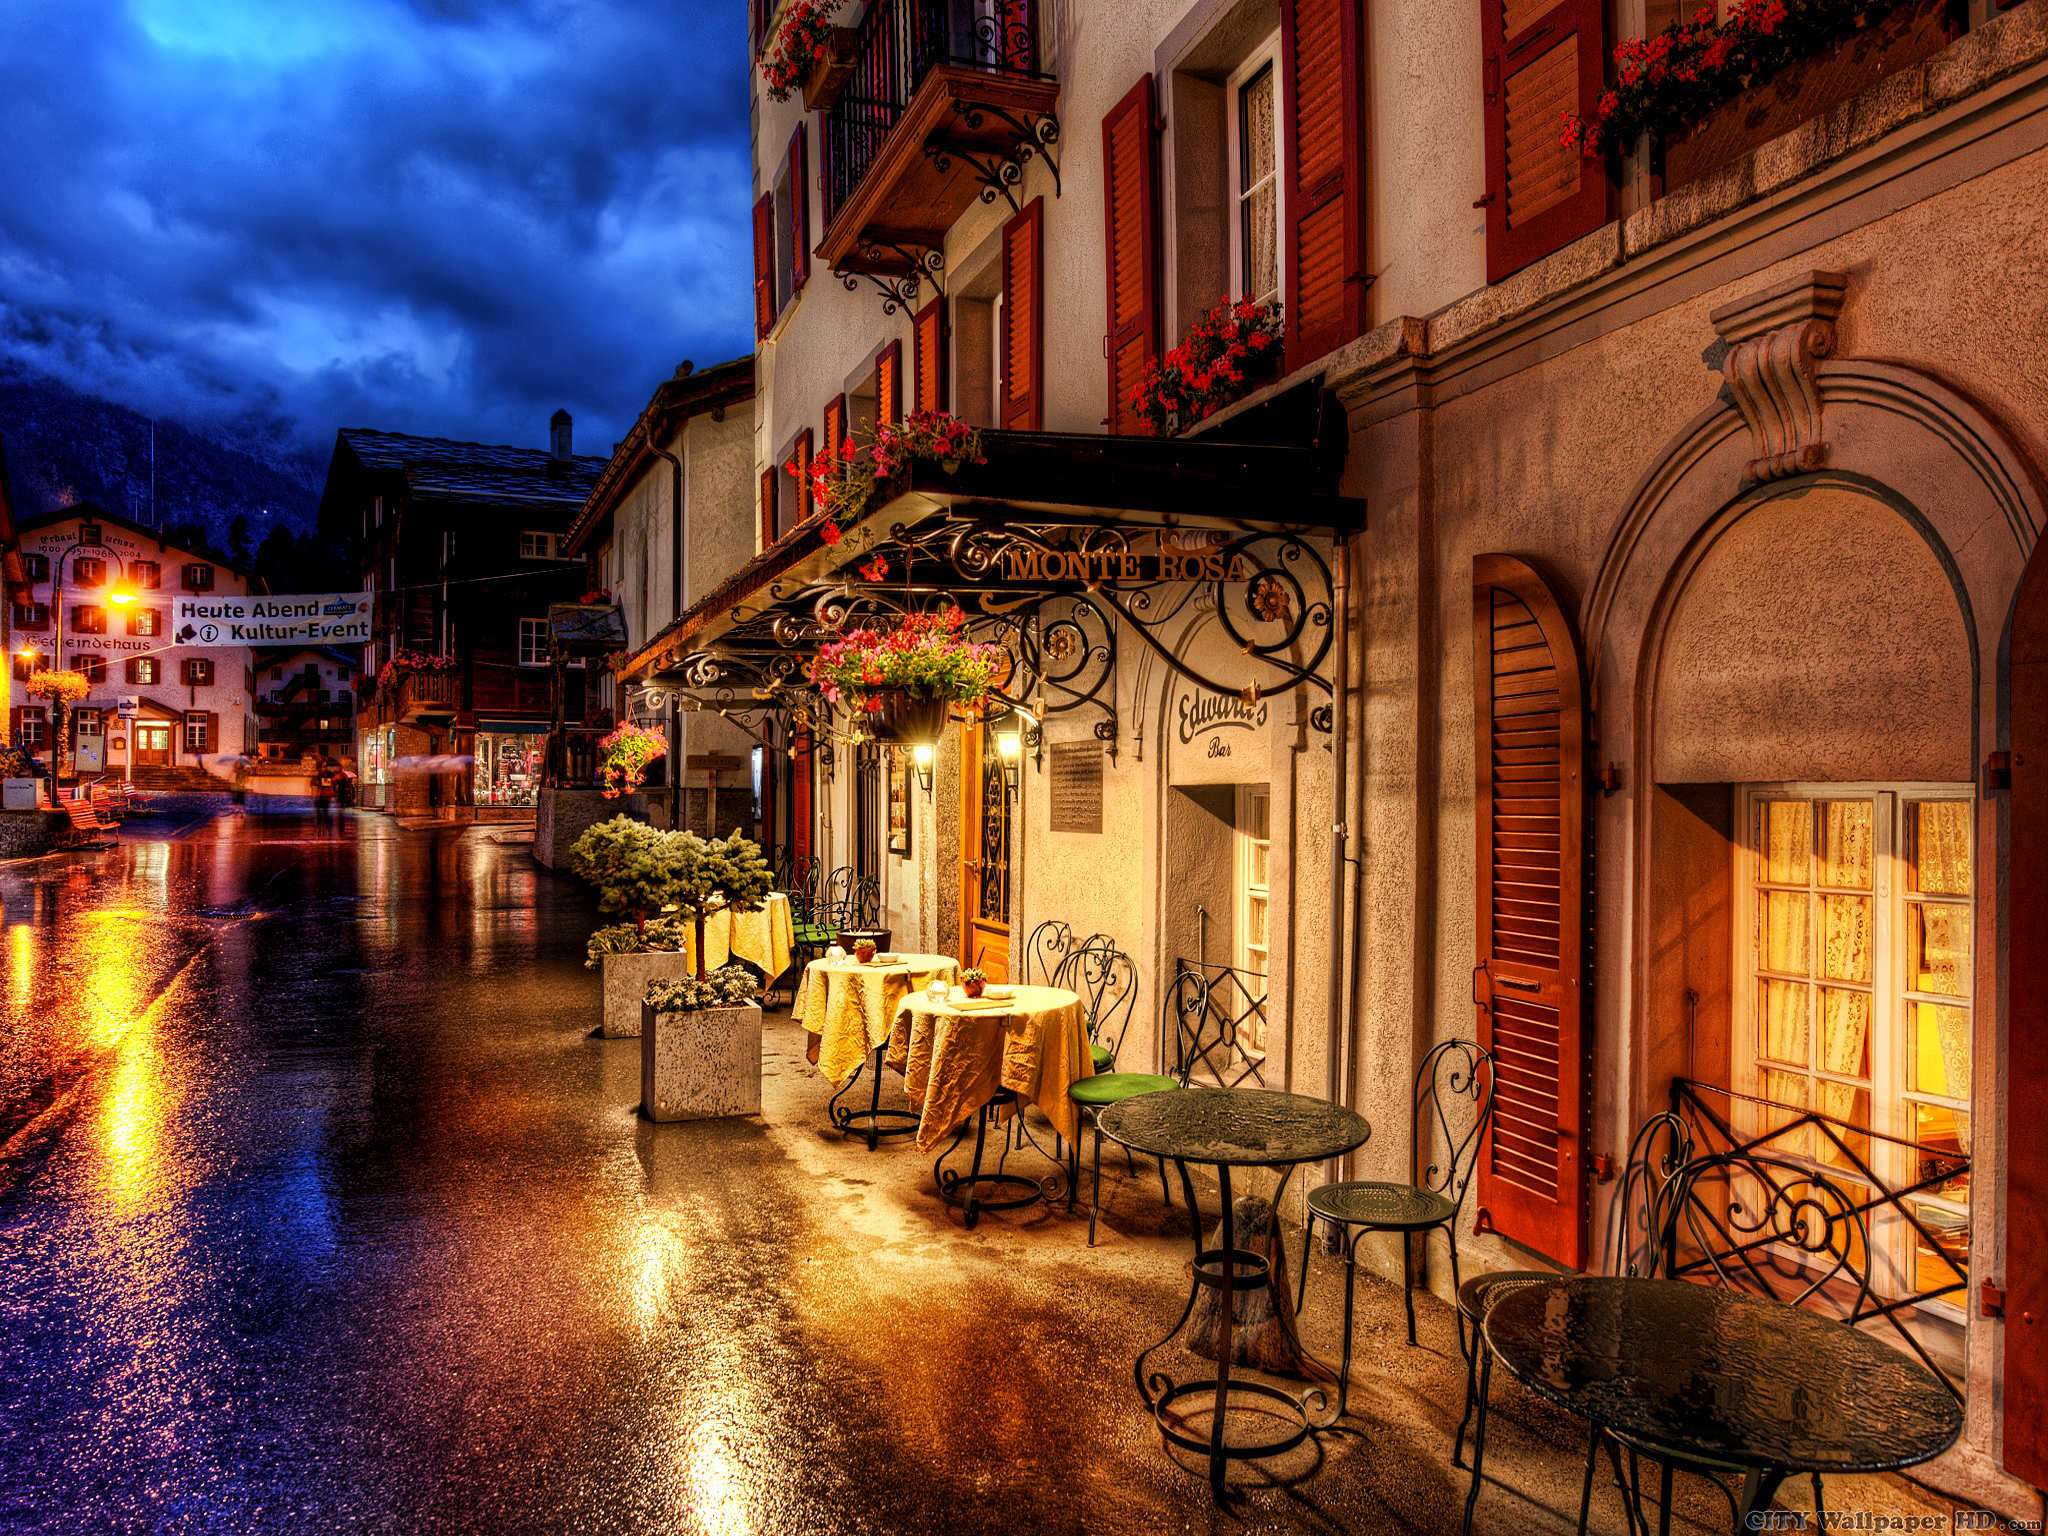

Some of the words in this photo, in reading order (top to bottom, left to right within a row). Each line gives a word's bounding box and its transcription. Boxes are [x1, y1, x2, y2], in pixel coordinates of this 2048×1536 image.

[1005, 550, 1141, 581] MONTE
[1155, 552, 1246, 582] ROSA
[181, 602, 245, 619] Heute
[251, 600, 319, 618] Abend
[231, 621, 369, 640] Kultur-Event
[1178, 688, 1268, 744] Edwars
[1207, 736, 1232, 759] Bar
